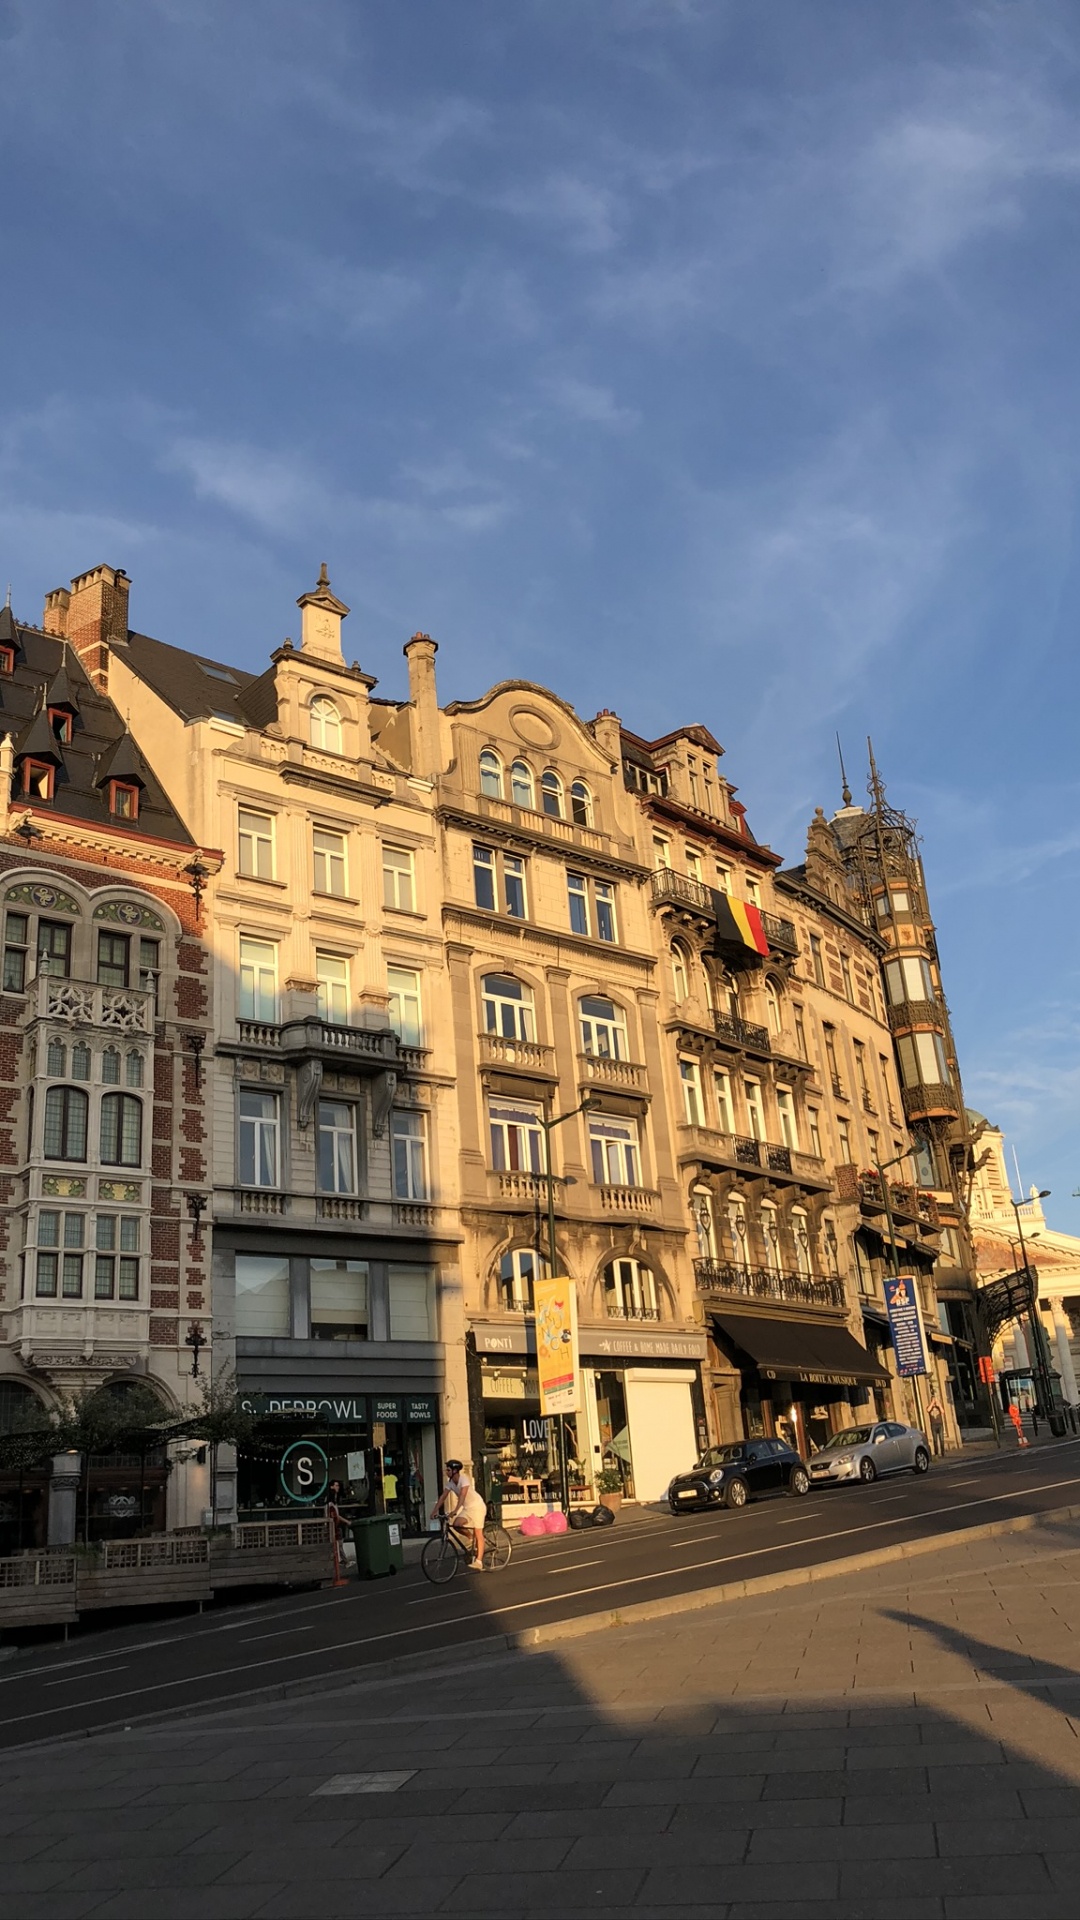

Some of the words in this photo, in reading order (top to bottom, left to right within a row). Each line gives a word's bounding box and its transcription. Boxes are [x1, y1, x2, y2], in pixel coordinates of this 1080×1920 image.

[613, 1340, 632, 1353] COFFEE
[640, 1341, 654, 1354] HOME
[655, 1342, 670, 1354] MADE
[671, 1343, 687, 1355] DAILY
[688, 1344, 701, 1356] FOOD
[766, 1370, 776, 1380] CD
[800, 1372, 808, 1382] LA
[832, 1375, 858, 1386] MUSIQUE
[875, 1379, 887, 1388] DVD
[377, 1402, 397, 1410] SUPER
[376, 1411, 398, 1419] FOODS
[523, 1419, 549, 1439] LOVE
[297, 1457, 313, 1485] S
